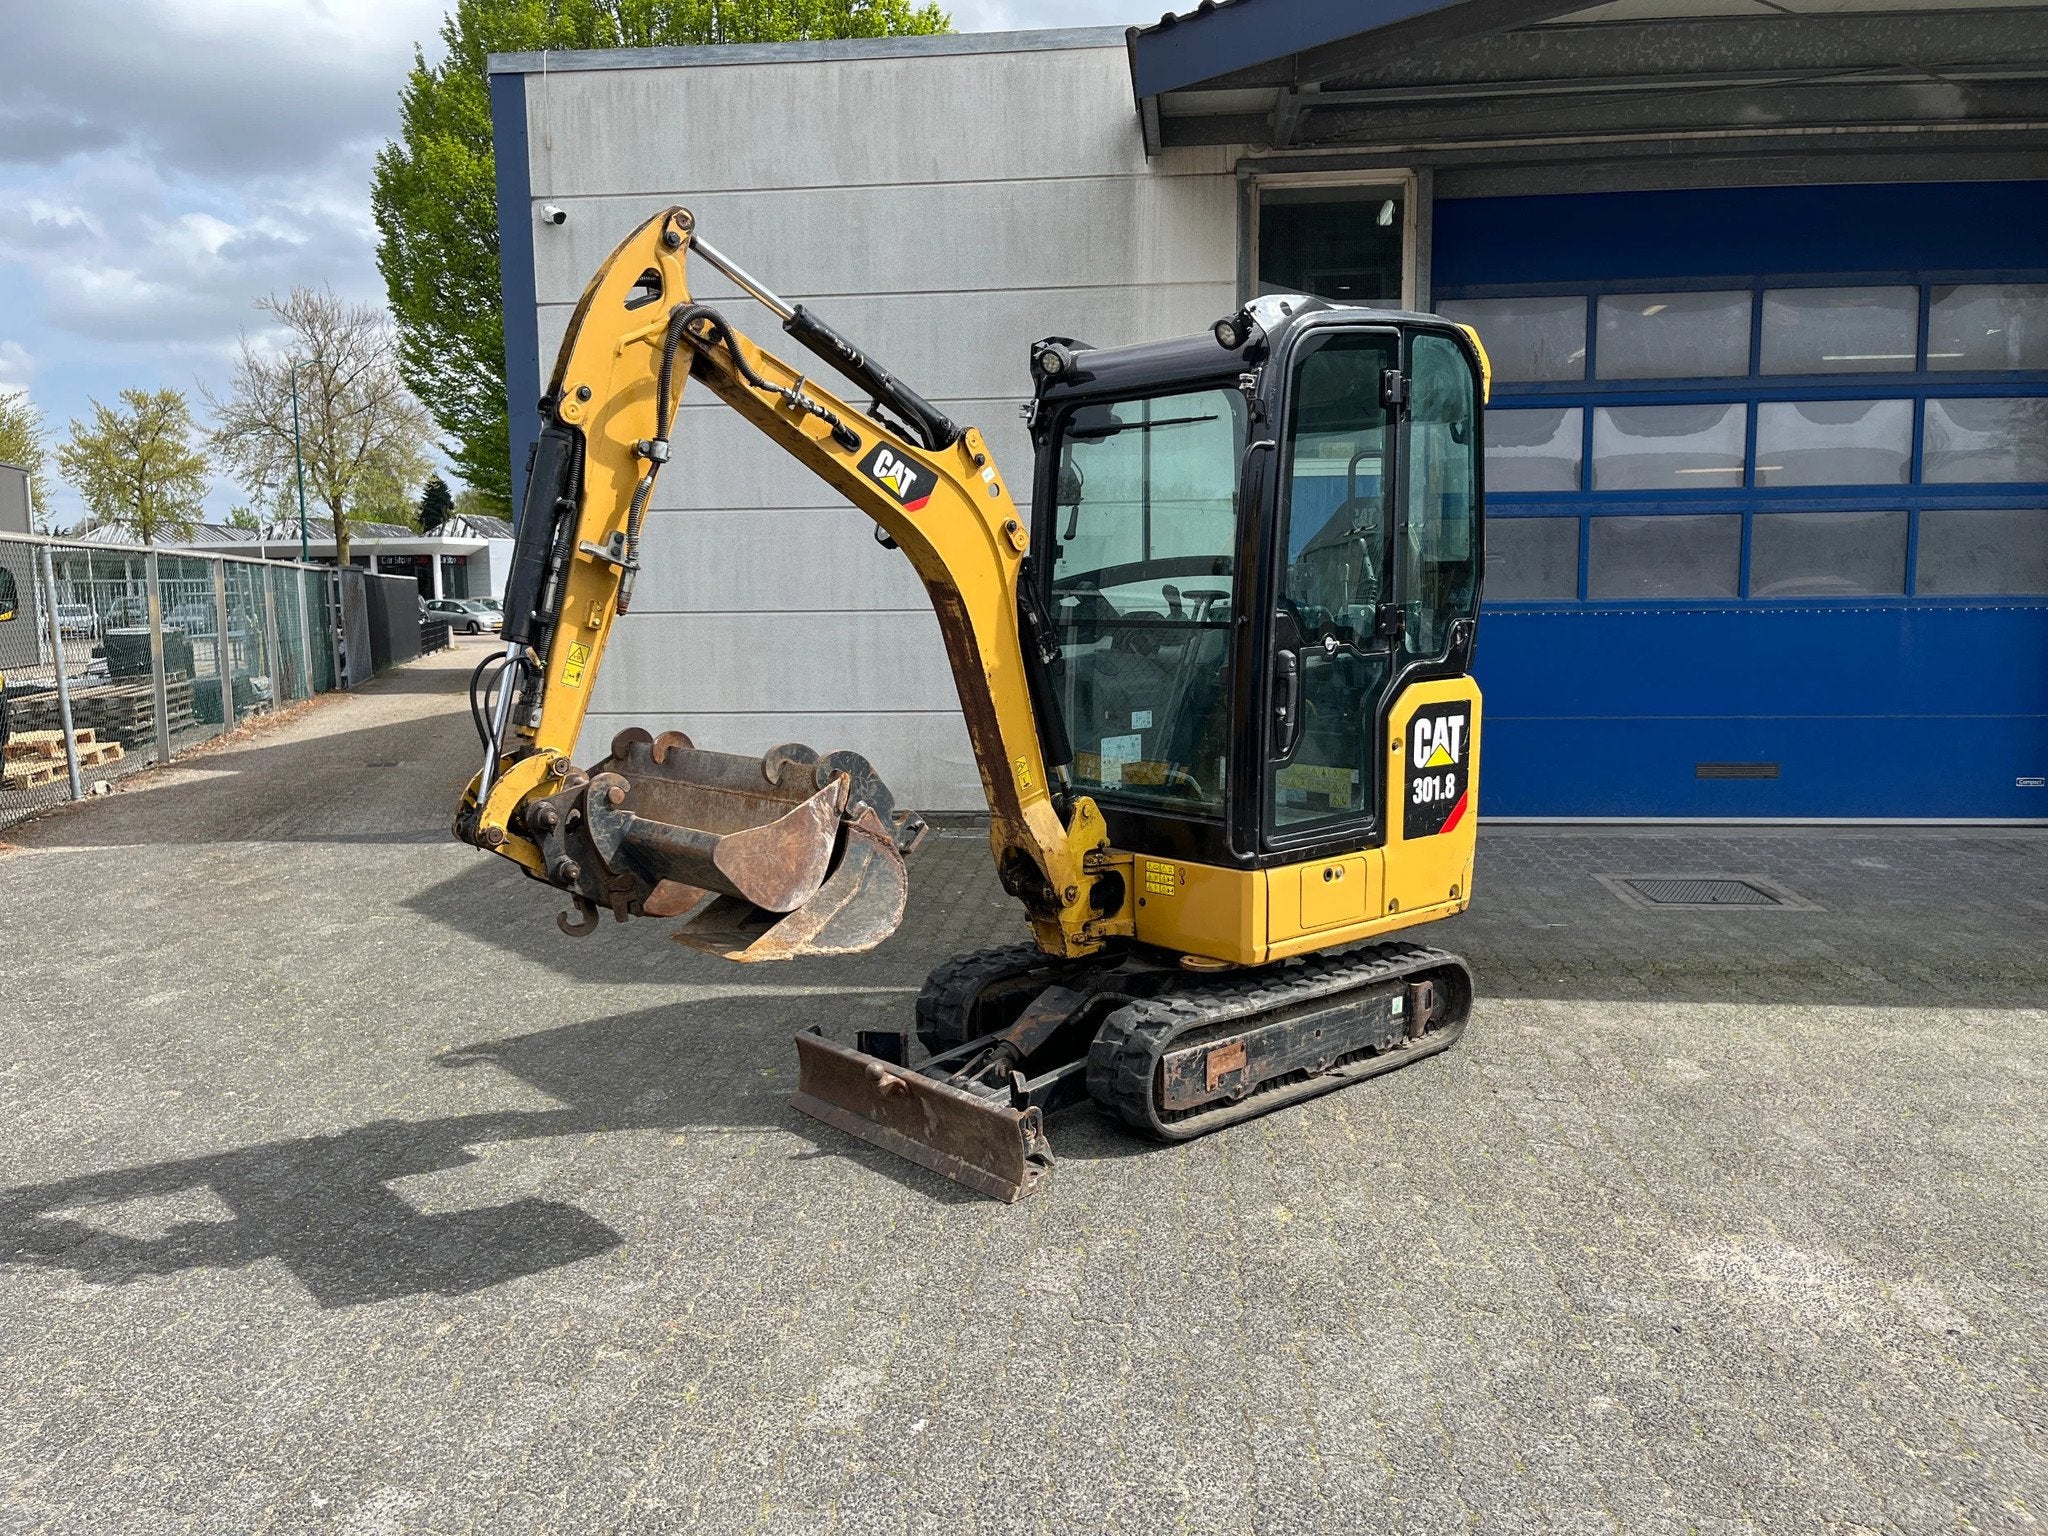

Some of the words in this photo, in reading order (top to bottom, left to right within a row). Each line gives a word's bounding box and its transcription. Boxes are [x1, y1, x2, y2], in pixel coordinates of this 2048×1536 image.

[872, 449, 918, 498] CAT
[1353, 508, 1377, 526] CAT
[1413, 714, 1465, 769] CAT
[1412, 772, 1456, 805] 301.8
